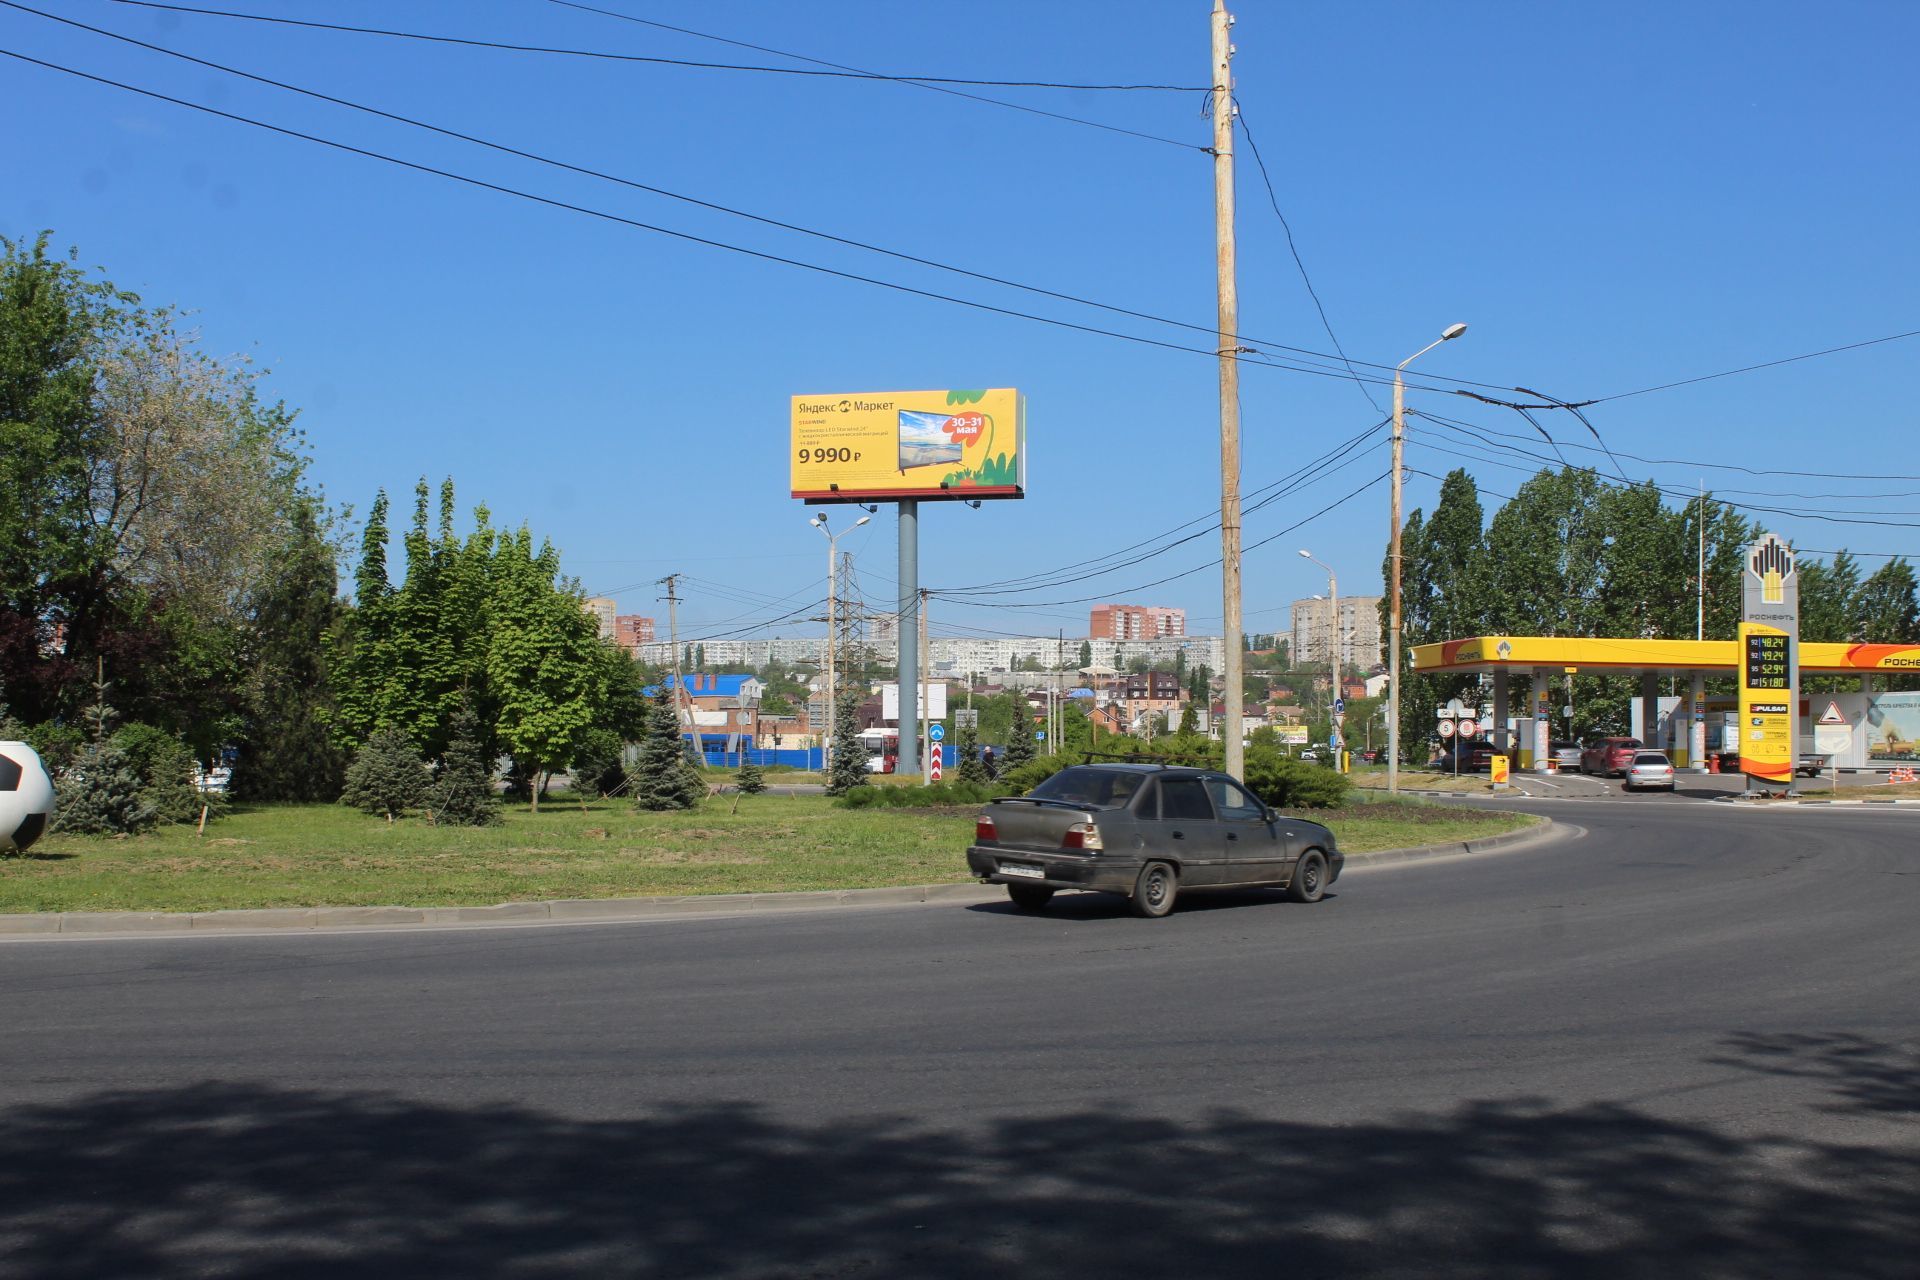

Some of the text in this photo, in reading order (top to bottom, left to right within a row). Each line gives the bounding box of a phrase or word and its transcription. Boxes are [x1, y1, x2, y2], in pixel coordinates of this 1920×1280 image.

[799, 400, 894, 414] Яндекс Маркет
[956, 426, 977, 434] мая
[814, 447, 851, 463] 990
[1749, 613, 1795, 621] РОСНЕФТЬ
[1762, 637, 1783, 647] 48.24
[1762, 651, 1783, 660] 49.24
[1762, 664, 1783, 674] 52.94
[1762, 677, 1783, 687] 51.80
[1444, 724, 1449, 732] 5
